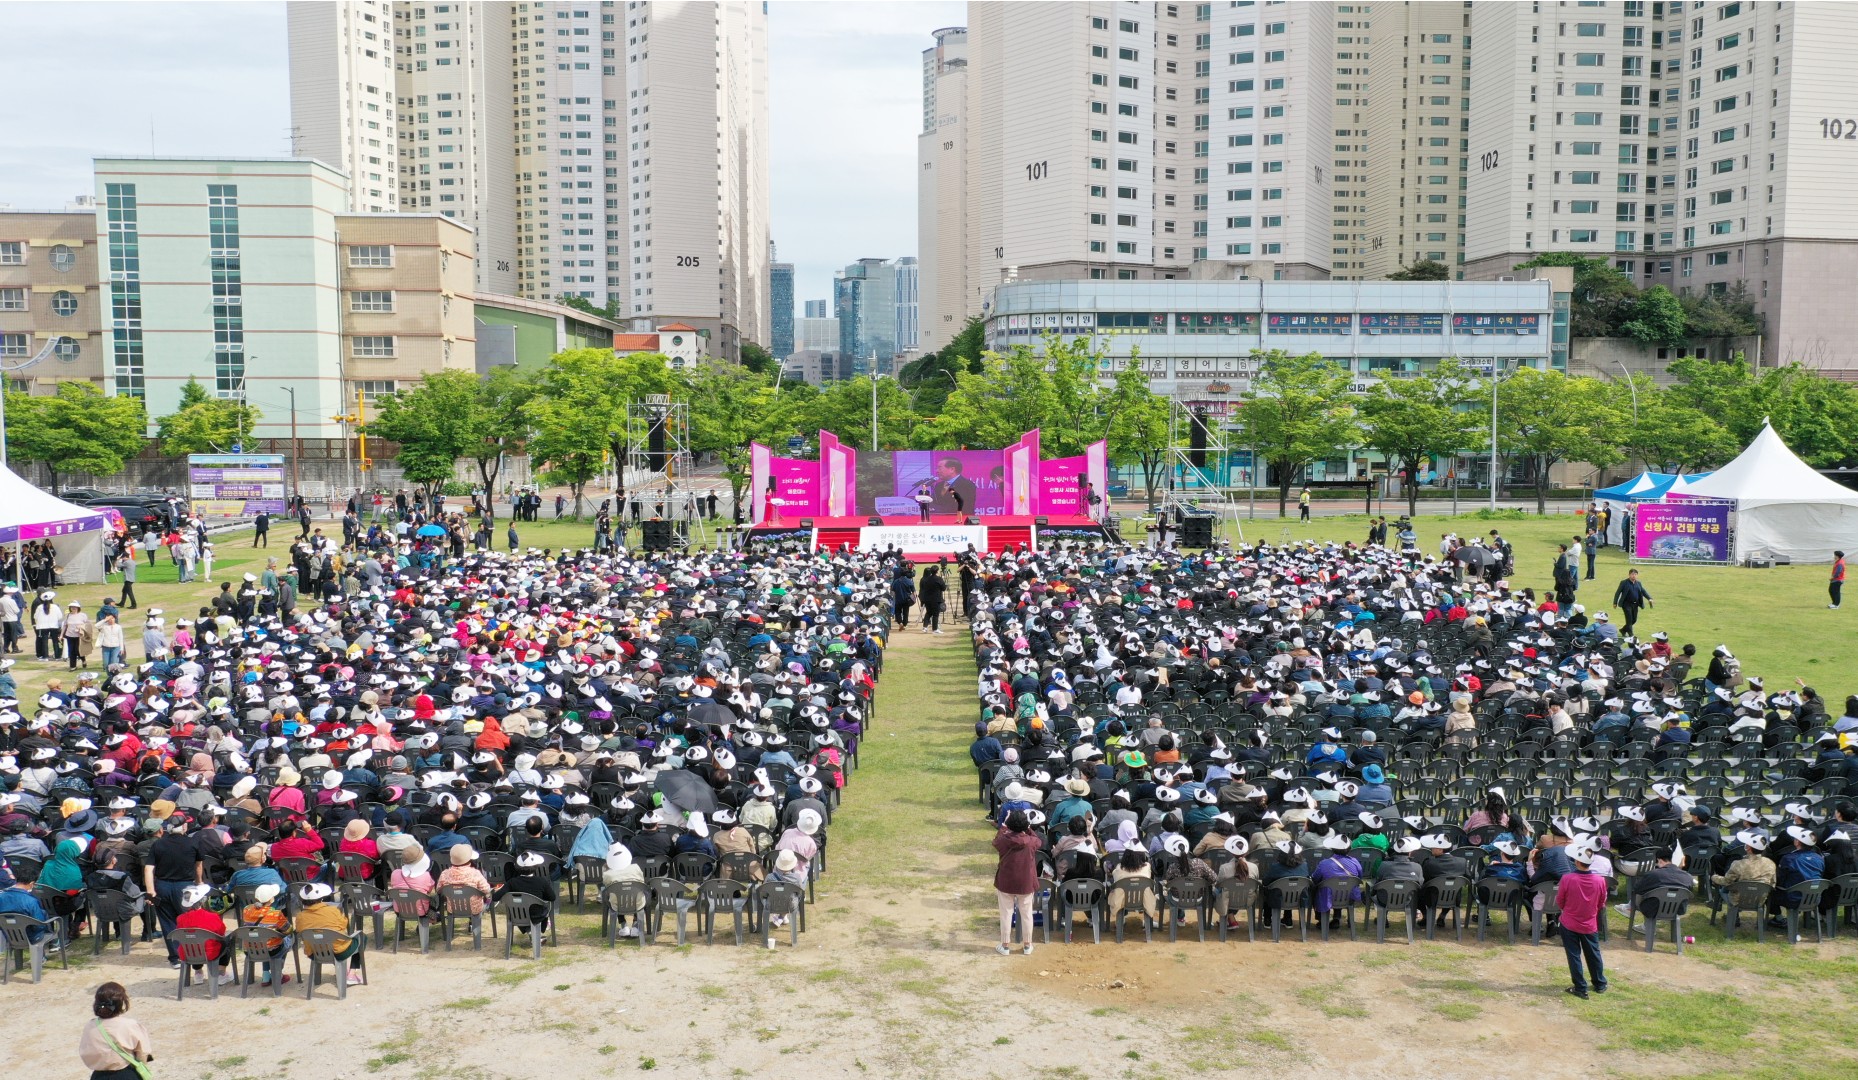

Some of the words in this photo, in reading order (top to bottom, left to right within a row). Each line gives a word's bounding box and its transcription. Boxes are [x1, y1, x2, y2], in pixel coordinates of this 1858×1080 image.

[1820, 118, 1857, 139] 102
[943, 140, 954, 151] 109
[923, 162, 932, 170] 111
[1480, 150, 1499, 172] 102
[1025, 160, 1048, 181] 101
[1371, 236, 1383, 251] 104
[994, 246, 1003, 259] 10
[497, 260, 510, 272] 206
[676, 255, 700, 267] 205
[943, 314, 953, 323] 109
[1313, 316, 1328, 325] 수학
[1334, 316, 1349, 325] 과학
[1498, 316, 1513, 325] 수학
[1520, 316, 1536, 325] 과학
[1181, 359, 1210, 370] 영어
[1644, 521, 1673, 532] 신청사
[1676, 522, 1696, 533] 건립
[1700, 523, 1720, 534] 착공
